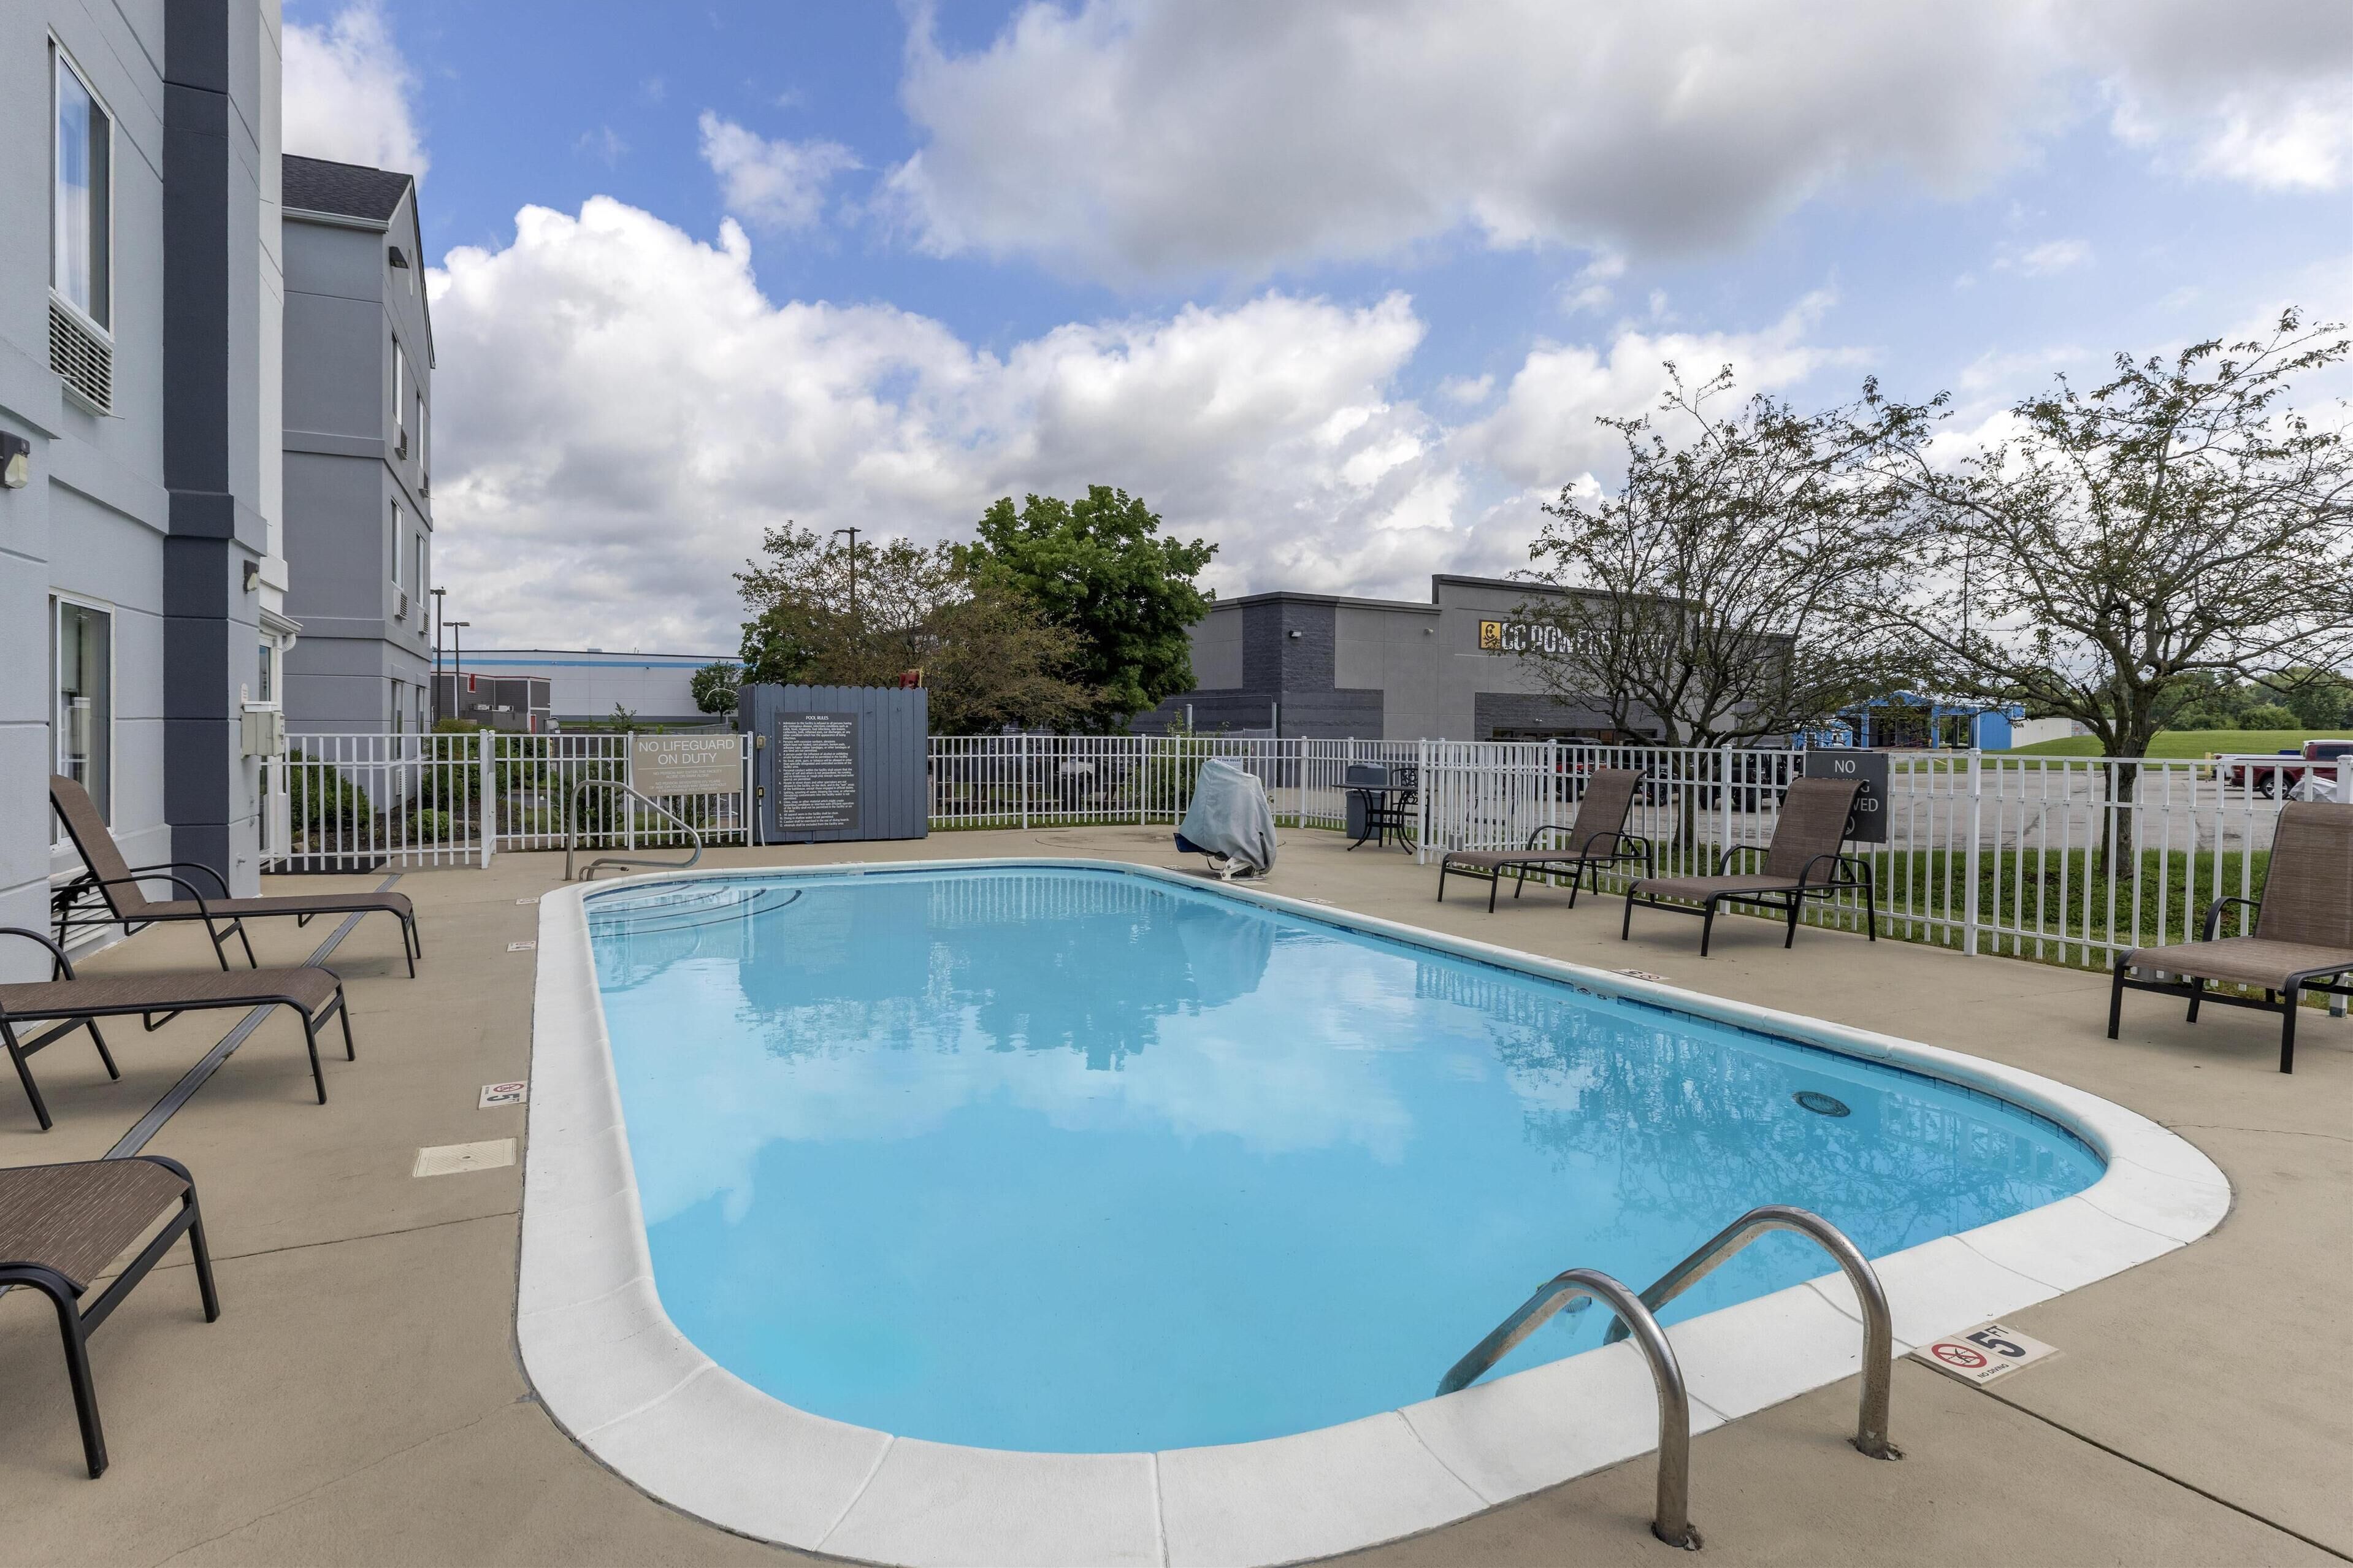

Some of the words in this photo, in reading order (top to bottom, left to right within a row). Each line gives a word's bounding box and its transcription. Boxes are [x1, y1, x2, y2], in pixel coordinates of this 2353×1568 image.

[639, 741, 659, 752] NO
[664, 740, 734, 752] LIFEGUARD
[658, 754, 678, 765] ON
[683, 752, 717, 764] DUTY
[1835, 760, 1856, 773] NO
[1984, 1325, 2009, 1337] FT
[1965, 1331, 2026, 1358] 5
[1990, 1363, 2010, 1374] DIVING
